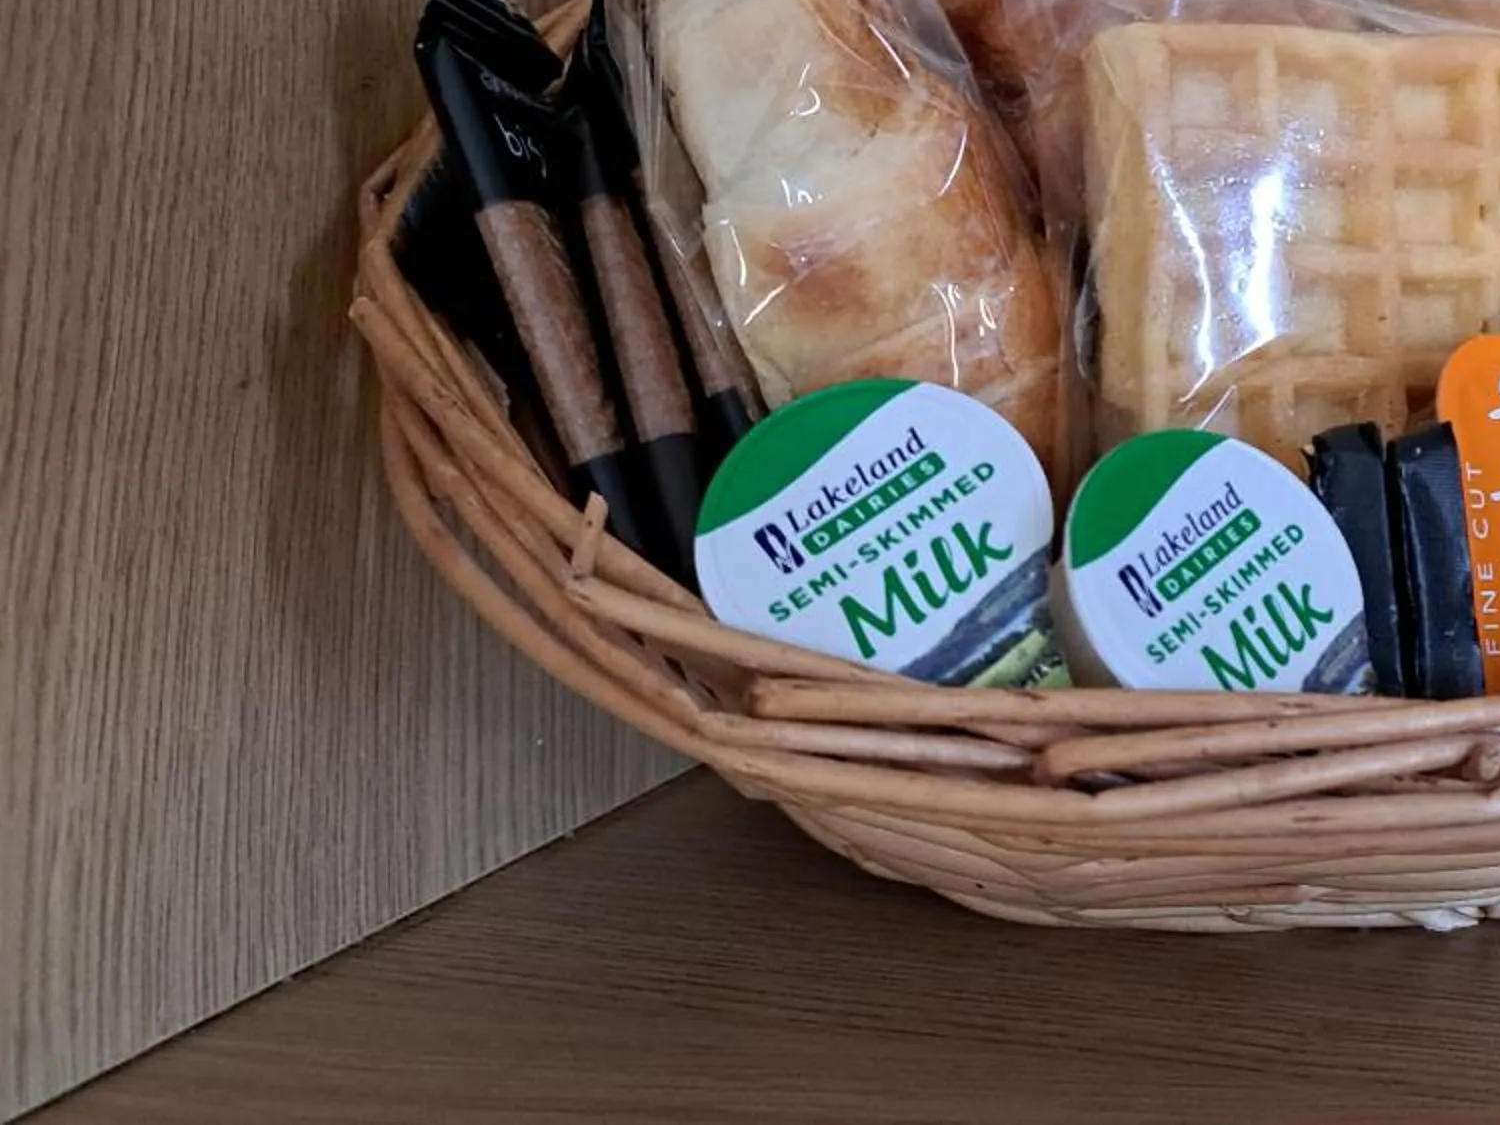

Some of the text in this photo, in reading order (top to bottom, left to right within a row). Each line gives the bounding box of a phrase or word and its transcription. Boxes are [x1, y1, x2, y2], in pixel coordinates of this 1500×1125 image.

[786, 427, 928, 534] Lakeland
[814, 459, 937, 548] DAIRIES
[1140, 481, 1244, 577] Lakeland
[1465, 463, 1490, 538] CUT
[768, 461, 995, 622] SEMI-SKIMMED
[838, 520, 1014, 659] Milk
[1146, 524, 1304, 663] SEMI-SKIMMED
[1165, 515, 1255, 593] DAIRIES
[1201, 581, 1334, 692] Milk
